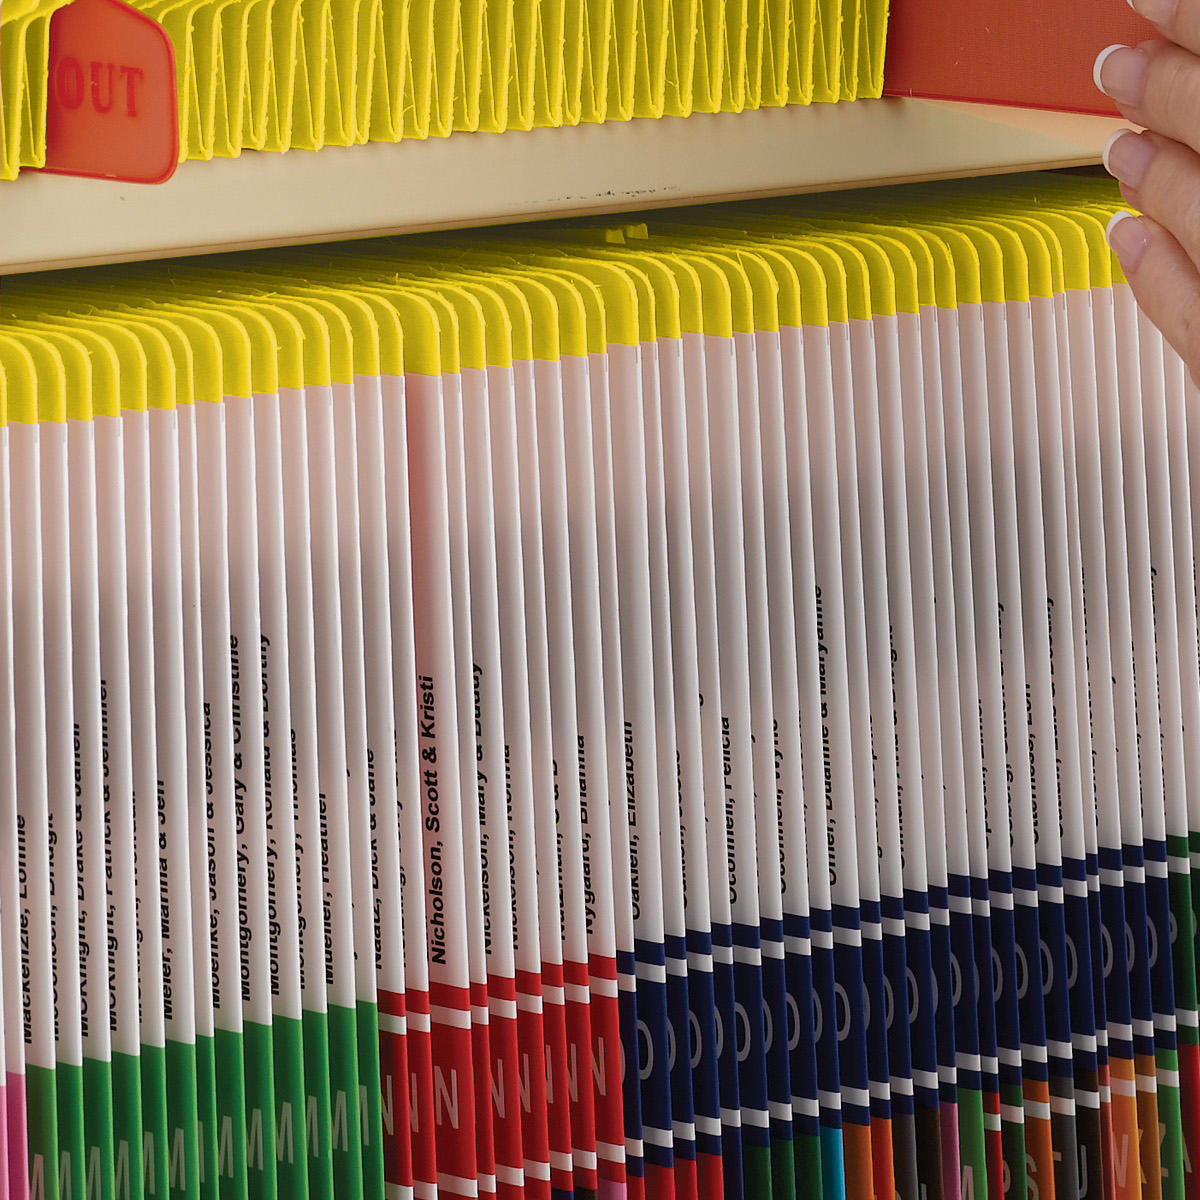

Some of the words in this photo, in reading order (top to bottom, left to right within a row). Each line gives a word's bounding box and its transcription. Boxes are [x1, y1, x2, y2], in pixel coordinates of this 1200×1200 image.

[56, 56, 144, 118] OUT
[419, 676, 435, 738] Kristi
[422, 747, 436, 763] &
[421, 770, 440, 832] Scott
[426, 841, 446, 965] Nicholson,
[434, 1066, 459, 1129] N
